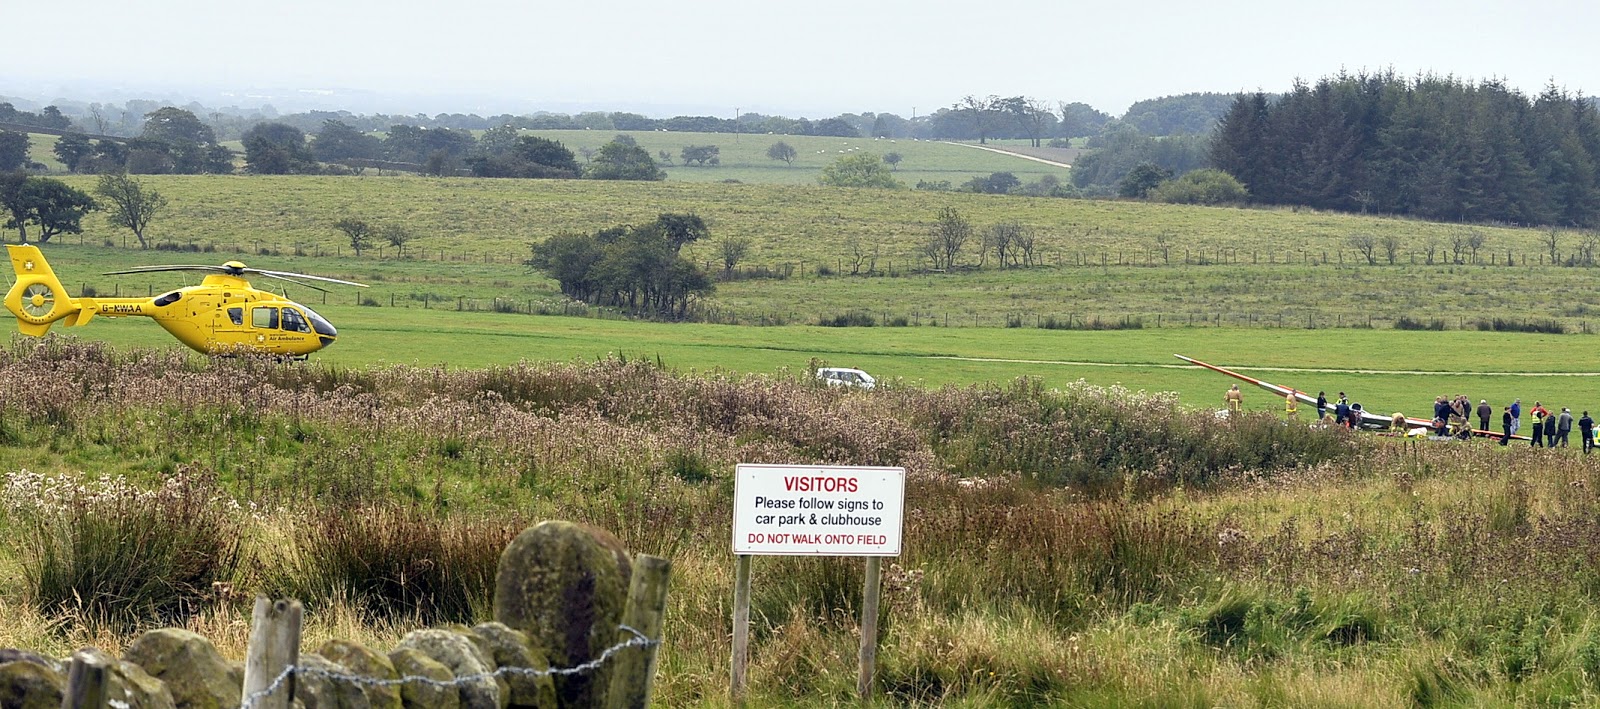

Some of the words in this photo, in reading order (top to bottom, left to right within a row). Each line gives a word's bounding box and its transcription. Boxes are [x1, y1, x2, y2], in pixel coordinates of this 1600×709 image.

[784, 476, 858, 493] VISITORS
[755, 496, 796, 509] Please
[799, 497, 834, 510] follow
[838, 498, 869, 512] signs
[872, 499, 884, 510] to
[755, 515, 776, 525] car
[778, 513, 806, 527] park
[808, 513, 818, 525] &
[821, 513, 882, 526] clubhouse
[748, 533, 765, 544] DO
[767, 533, 790, 544] NOT
[792, 534, 822, 545] WALK
[825, 534, 855, 545] ONTO
[857, 535, 887, 545] FIELD
